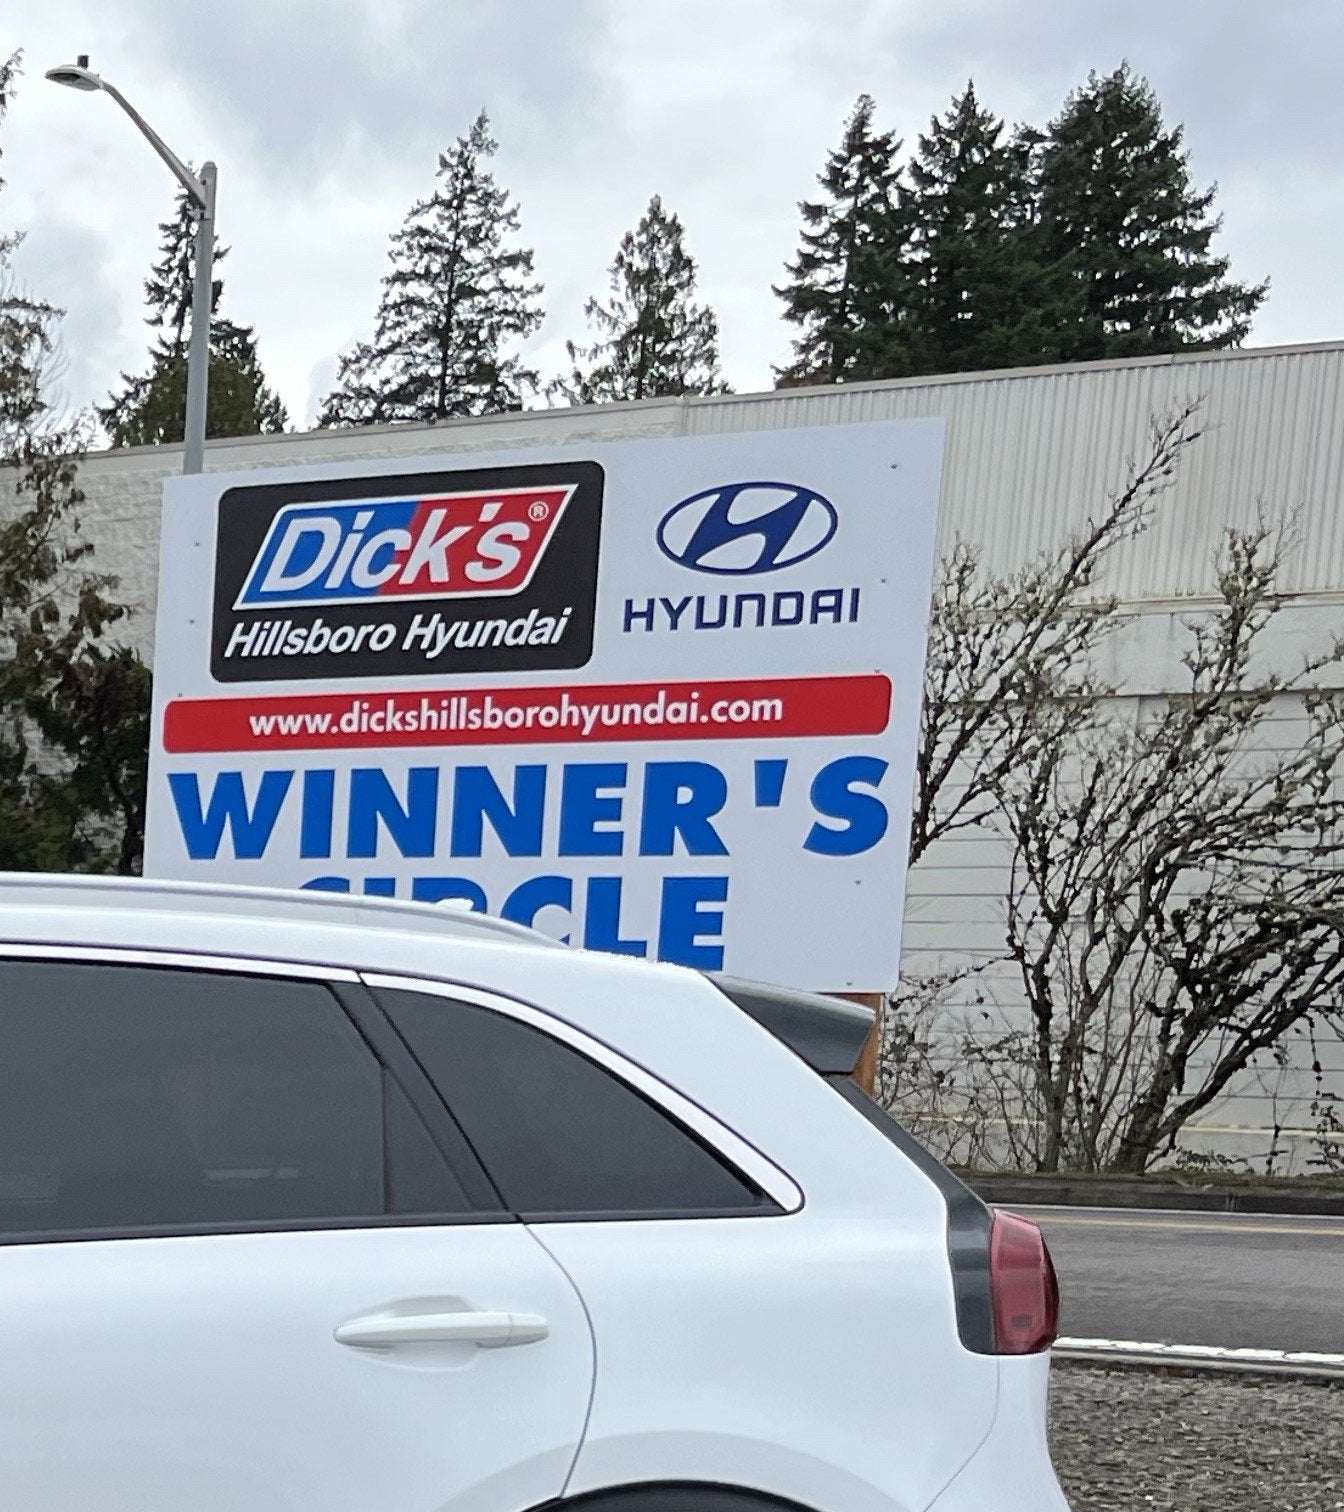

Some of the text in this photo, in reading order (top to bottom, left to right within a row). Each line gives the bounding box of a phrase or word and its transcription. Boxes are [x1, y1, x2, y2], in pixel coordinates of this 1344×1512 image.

[224, 606, 574, 660] Hillsboro Hyundai
[622, 587, 860, 634] HYUNDAI
[249, 690, 784, 738] www.dickshillsborohyundai.com
[168, 755, 891, 862] WINNER'S
[299, 874, 730, 971] CLE
